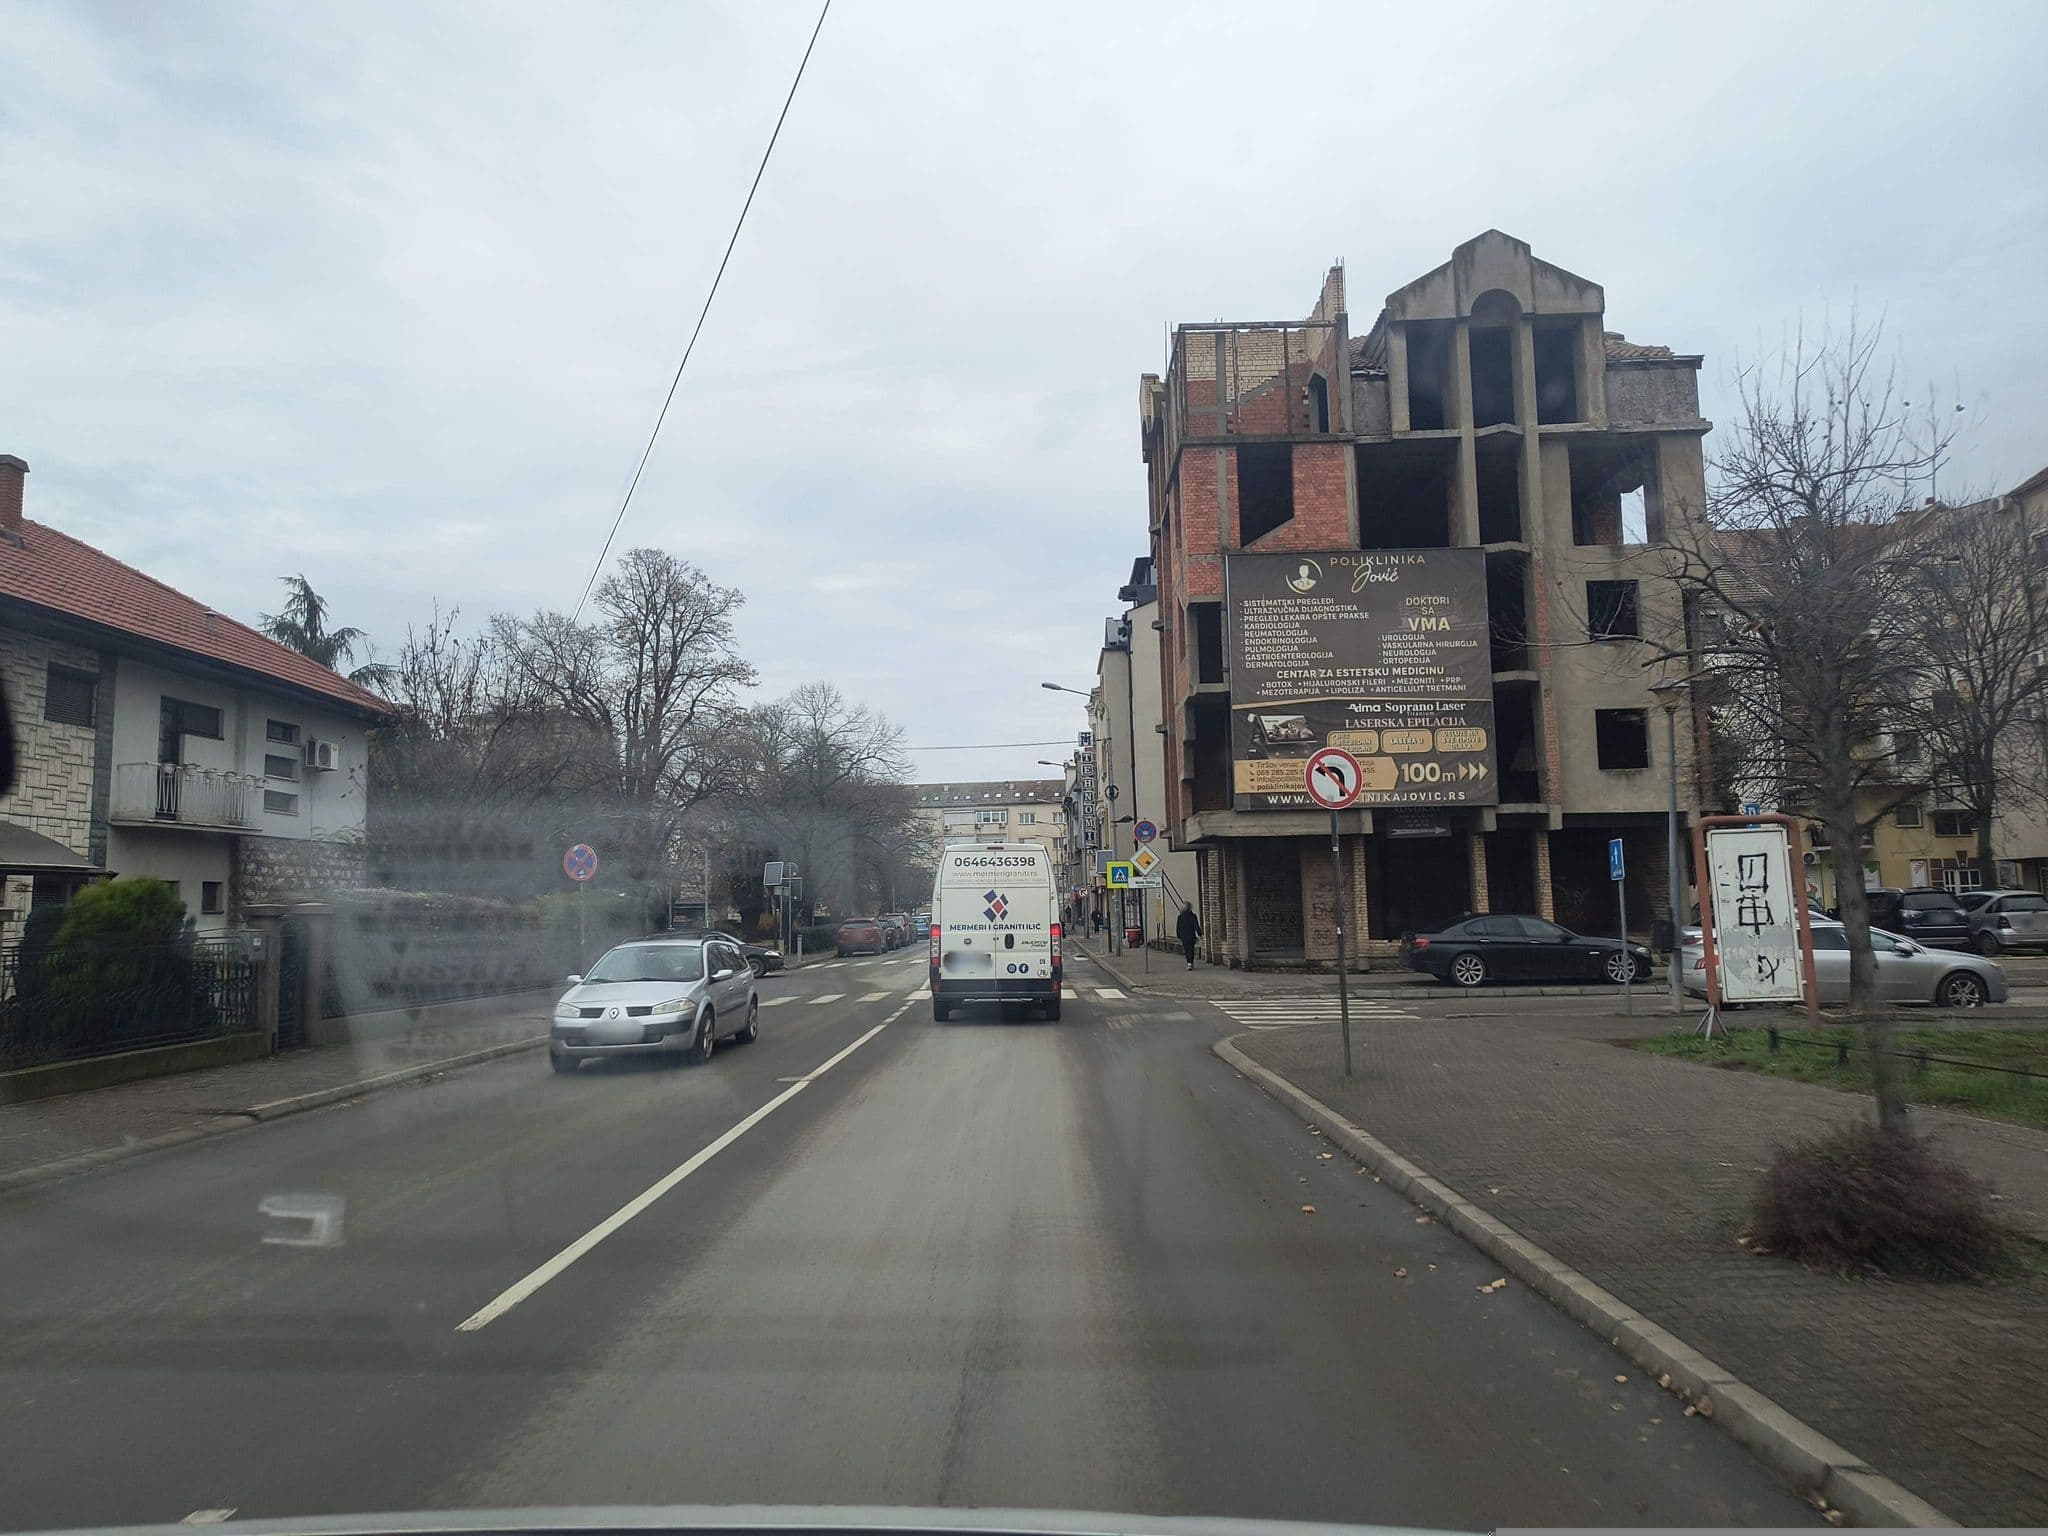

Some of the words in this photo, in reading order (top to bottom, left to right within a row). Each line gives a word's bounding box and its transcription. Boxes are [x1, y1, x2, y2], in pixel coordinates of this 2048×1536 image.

[1329, 555, 1426, 566] POLIKLINIKA
[1351, 562, 1399, 593] Jović
[1243, 599, 1295, 608] SISTEMATSKI
[1296, 598, 1334, 606] PREGLEDI
[1405, 596, 1450, 606] DOKTORI
[1244, 606, 1300, 615] ULTRAZVUČNA
[1301, 605, 1358, 613] DIJAGNOSTIKA
[1421, 606, 1436, 615] SA
[1244, 614, 1279, 622] PREGLED
[1280, 613, 1311, 621] LEKARA
[1312, 611, 1337, 620] OPŠTE
[1339, 612, 1370, 620] PRAKSE
[1244, 622, 1301, 630] KARDIOLOGIJA
[1407, 616, 1451, 631] VMA
[1244, 629, 1309, 638] REUMATOLOGIJA
[1381, 634, 1426, 642] UROLOGIJA
[1244, 637, 1318, 645] ENDOKRINOLOGIJA
[1382, 641, 1434, 649] VASKULARNA
[1436, 640, 1478, 648] HIRURGIJA
[1245, 645, 1299, 653] PULMOLOGIJA
[1382, 649, 1437, 657] NEUROLOGIJA
[1245, 652, 1334, 661] GASTROENTEROLOGIJA
[1382, 656, 1431, 664] ORTOPEDIJA
[1245, 660, 1310, 669] DERMATOLOGIJA
[1276, 669, 1317, 679] CENTAR
[1319, 669, 1333, 678] ZA
[1336, 668, 1389, 677] ESTETSKU
[1392, 666, 1445, 676] MEDICINU
[1303, 679, 1360, 687] HIJALURONSKI
[1362, 678, 1386, 686] FILERI
[1396, 677, 1435, 685] MEZONITI
[1261, 688, 1321, 696] MEZOTERAPIJA
[1330, 686, 1365, 694] LIPOLIZA
[1375, 685, 1425, 693] ANTICELULIT
[1426, 684, 1466, 692] TRETMANI
[1385, 702, 1434, 714] Soprano
[1436, 701, 1466, 711] Laser
[1345, 718, 1405, 729] LASERSKA
[1407, 717, 1467, 727] EPILACIJA
[954, 857, 1036, 867] 0646436398
[1025, 922, 1041, 930] ILIĆ
